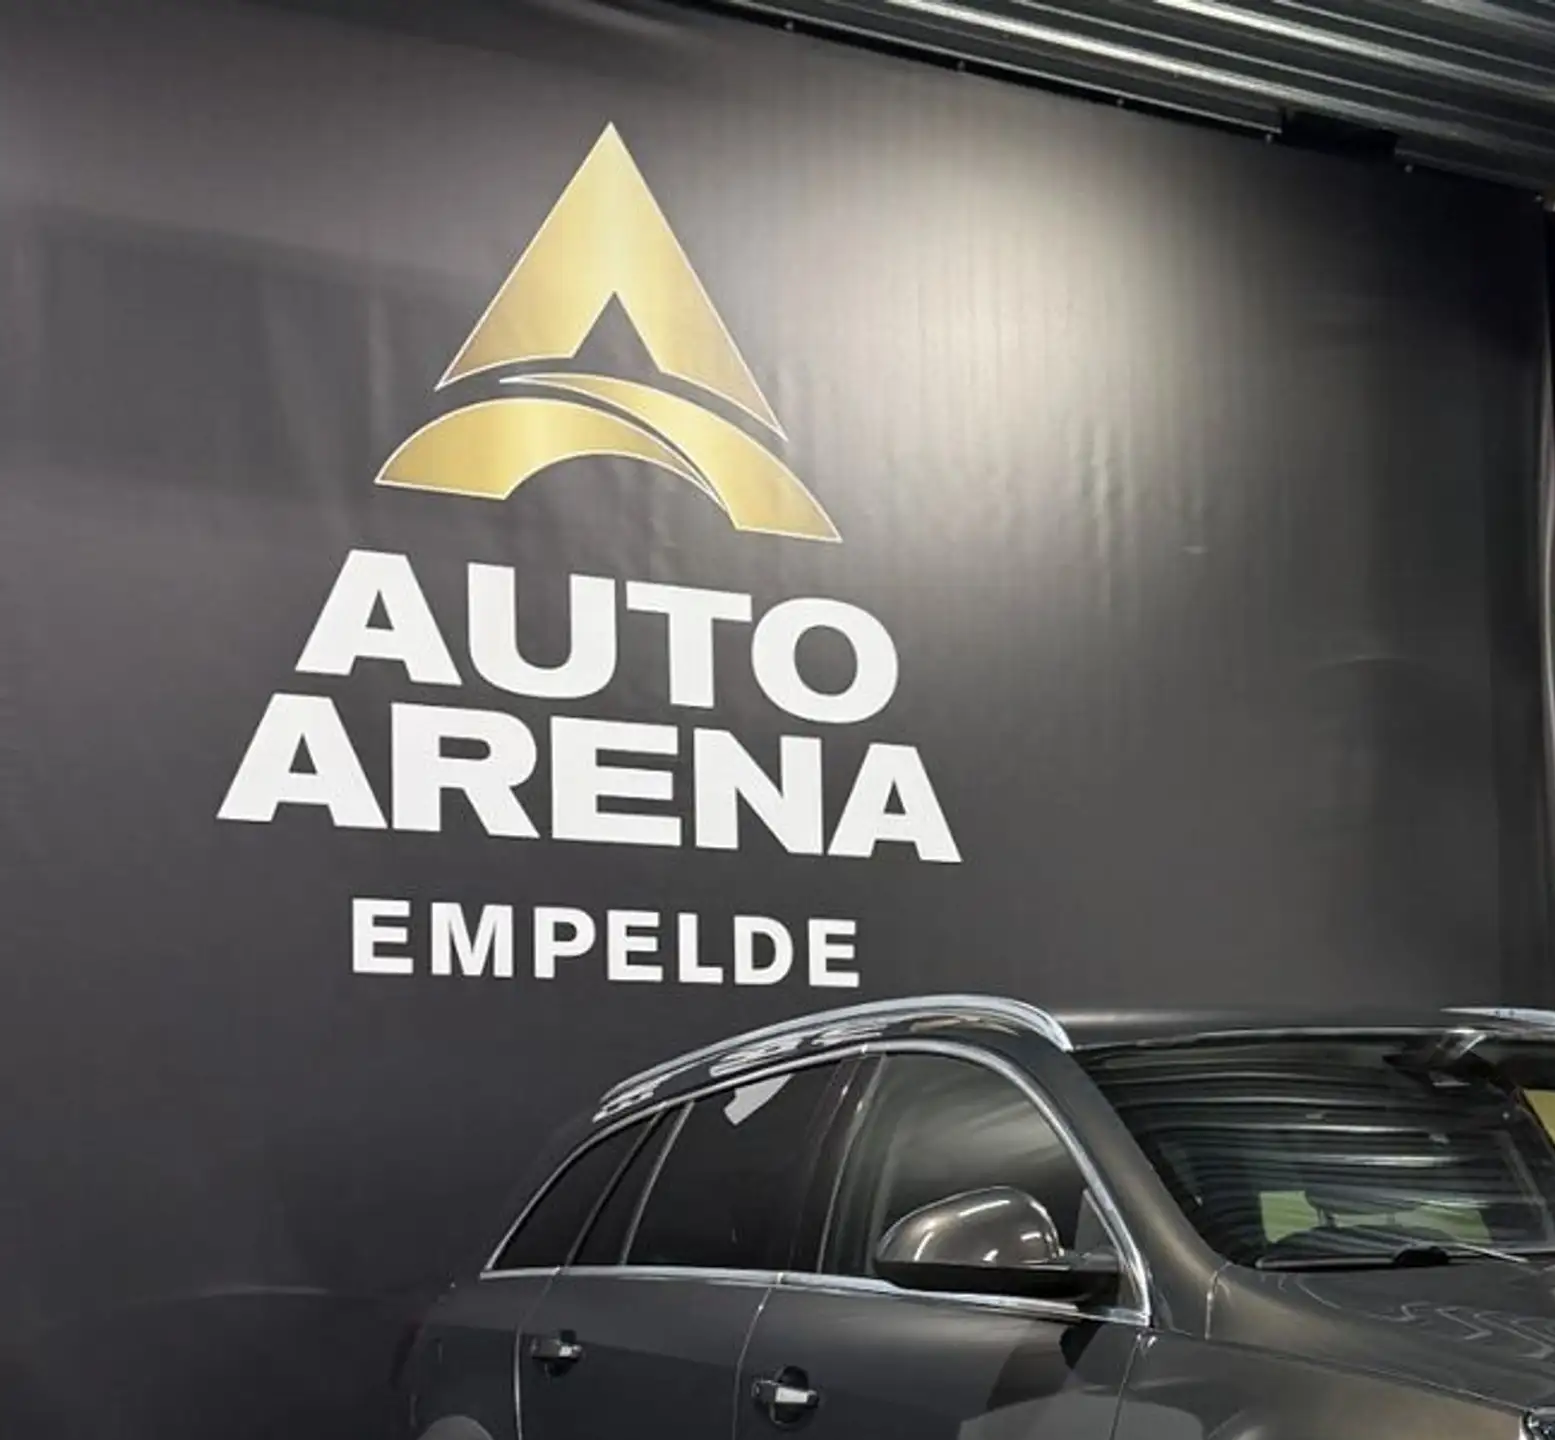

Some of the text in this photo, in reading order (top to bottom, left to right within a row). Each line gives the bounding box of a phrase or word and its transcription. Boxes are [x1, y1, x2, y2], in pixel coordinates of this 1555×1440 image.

[295, 549, 898, 723] AUTO
[216, 692, 962, 863] ARENA
[351, 897, 860, 987] EMPELDE
